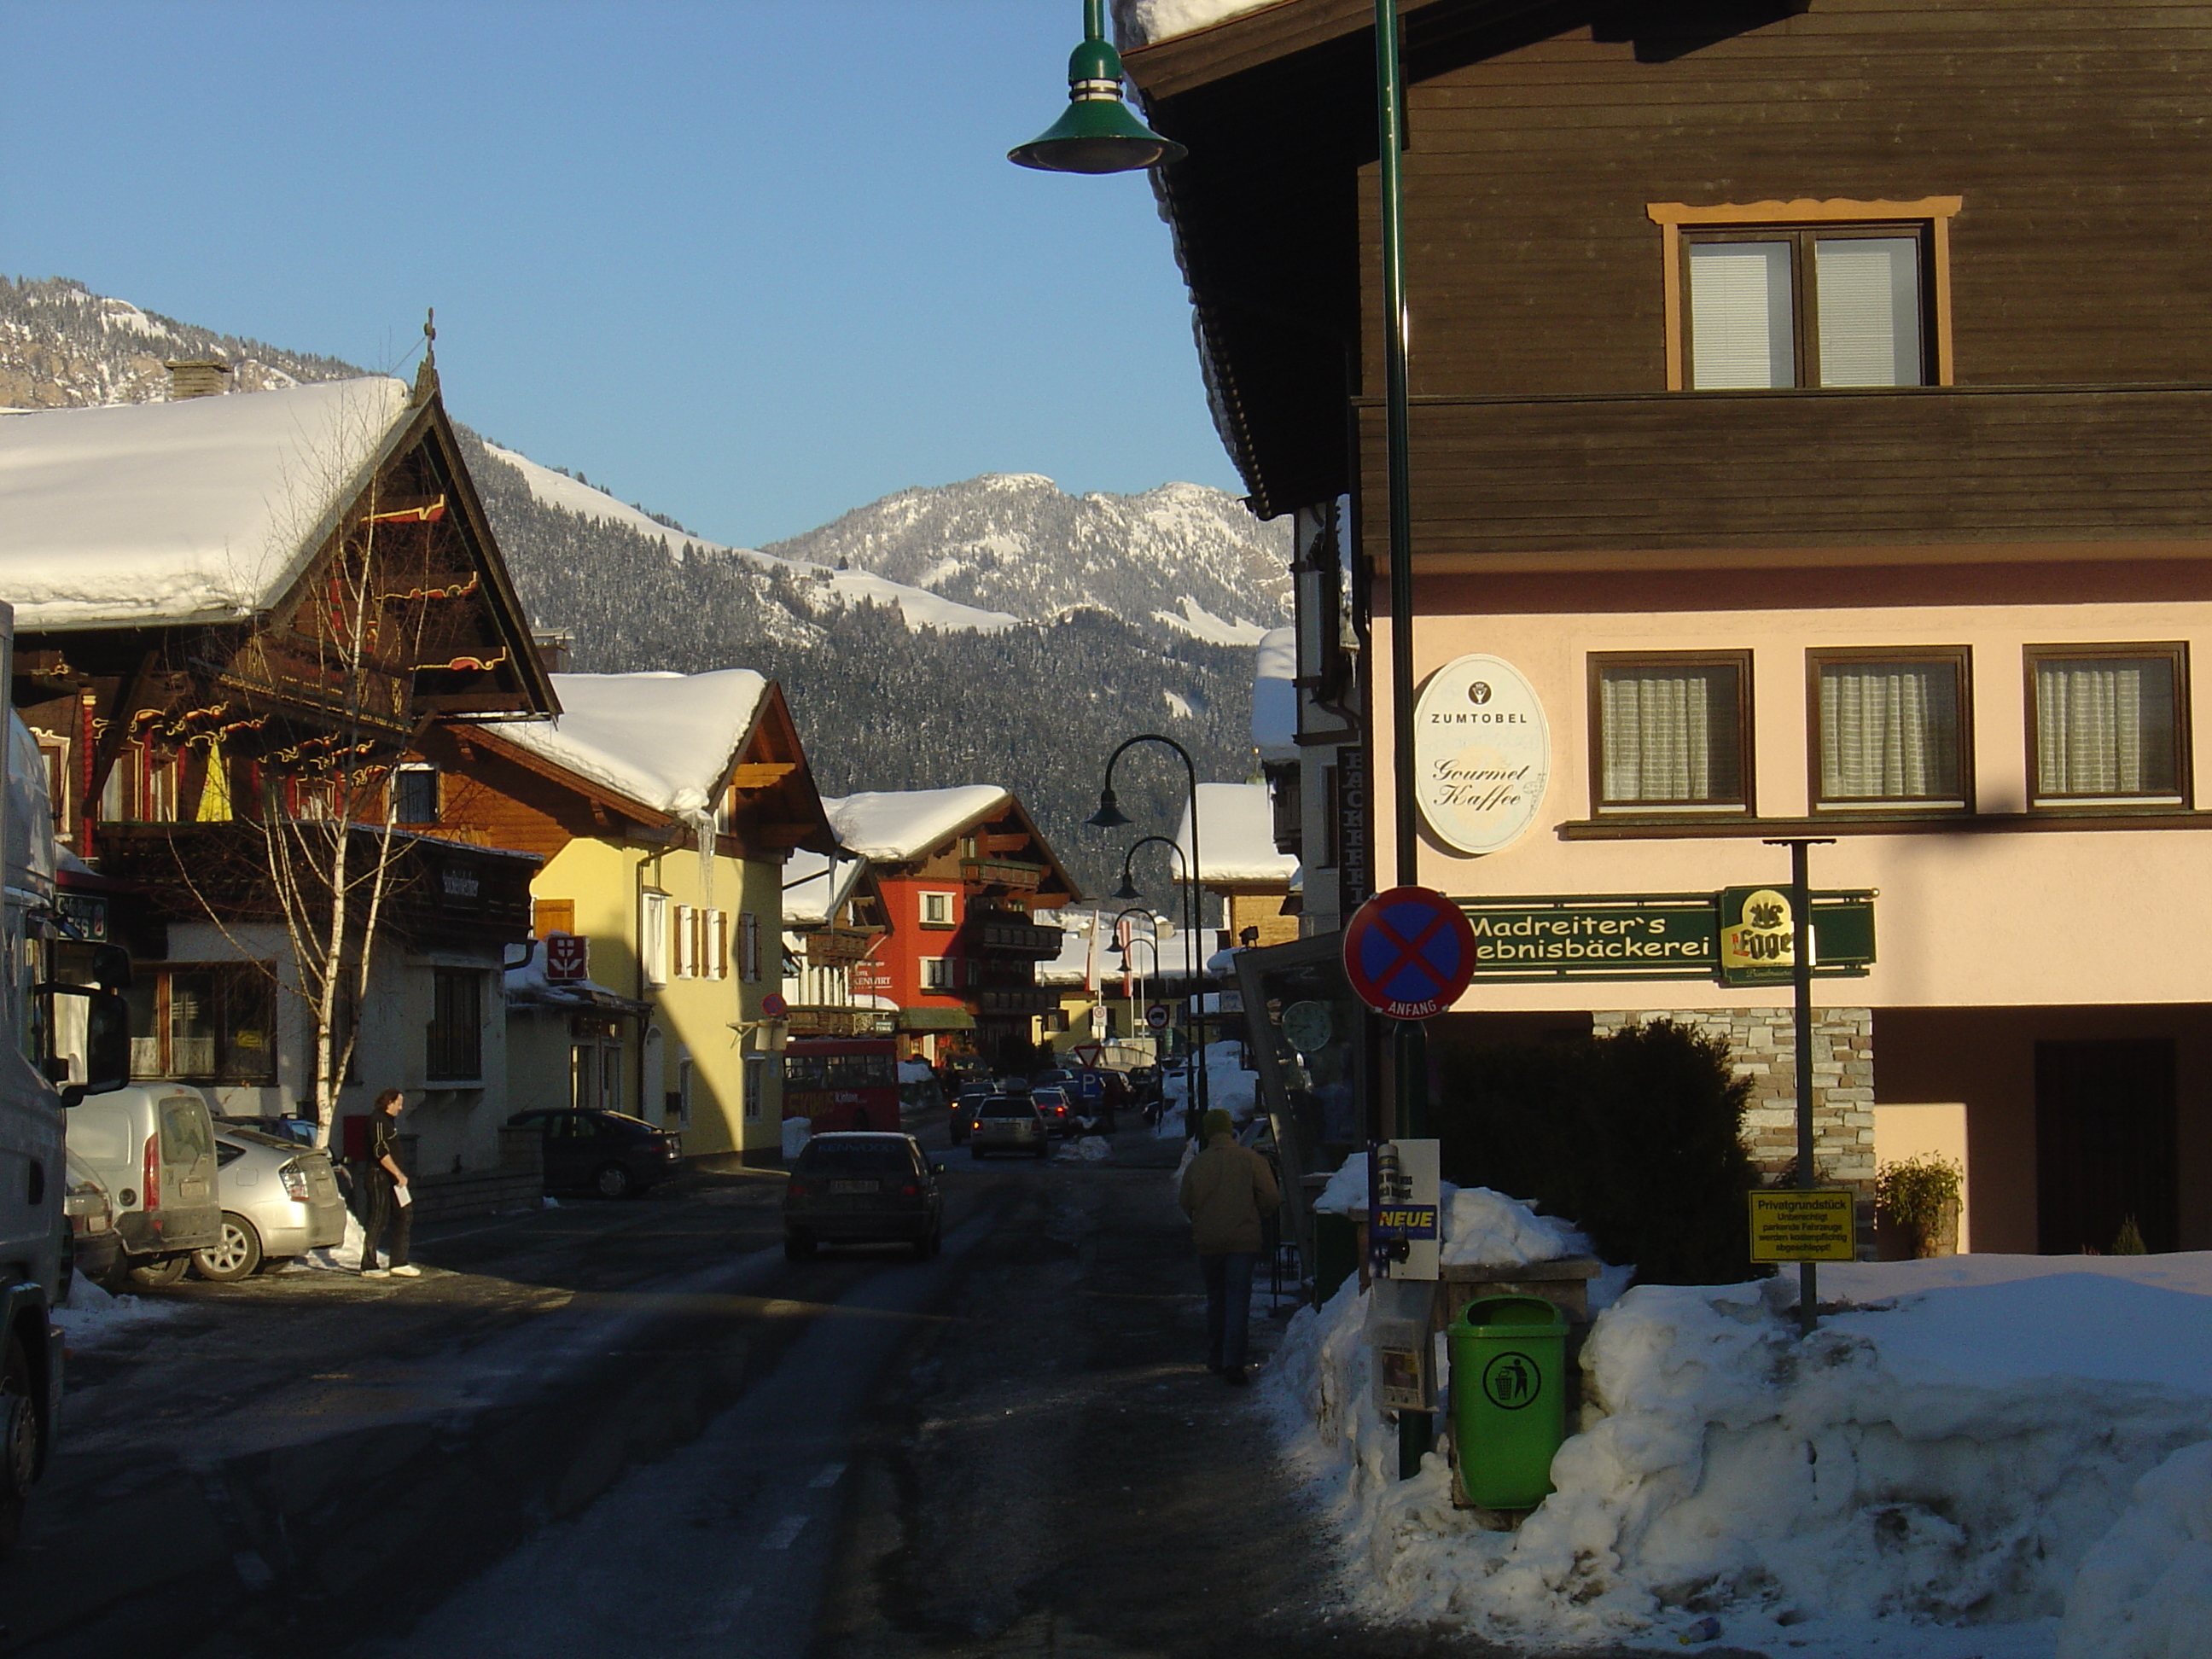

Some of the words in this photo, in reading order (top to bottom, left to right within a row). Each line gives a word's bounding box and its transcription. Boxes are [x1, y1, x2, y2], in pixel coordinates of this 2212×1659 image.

[1431, 713, 1528, 724] ZUMTOBEL
[1432, 759, 1531, 781] Gourmet
[1433, 783, 1522, 812] Kaffee
[1477, 936, 1709, 960] ebnisbäckerei
[1388, 999, 1437, 1016] ANFANG
[1082, 1074, 1096, 1092] P
[818, 1143, 896, 1153] KENWOOD
[1758, 1200, 1847, 1211] Privatgrundstück
[1378, 1210, 1435, 1227] NEUE
[1778, 1214, 1828, 1222] Unberechtigt
[1802, 1223, 1842, 1232] Fahrzeuge
[1790, 1233, 1848, 1243] kostenpflichtig
[1776, 1243, 1831, 1253] abgeschleppt!
